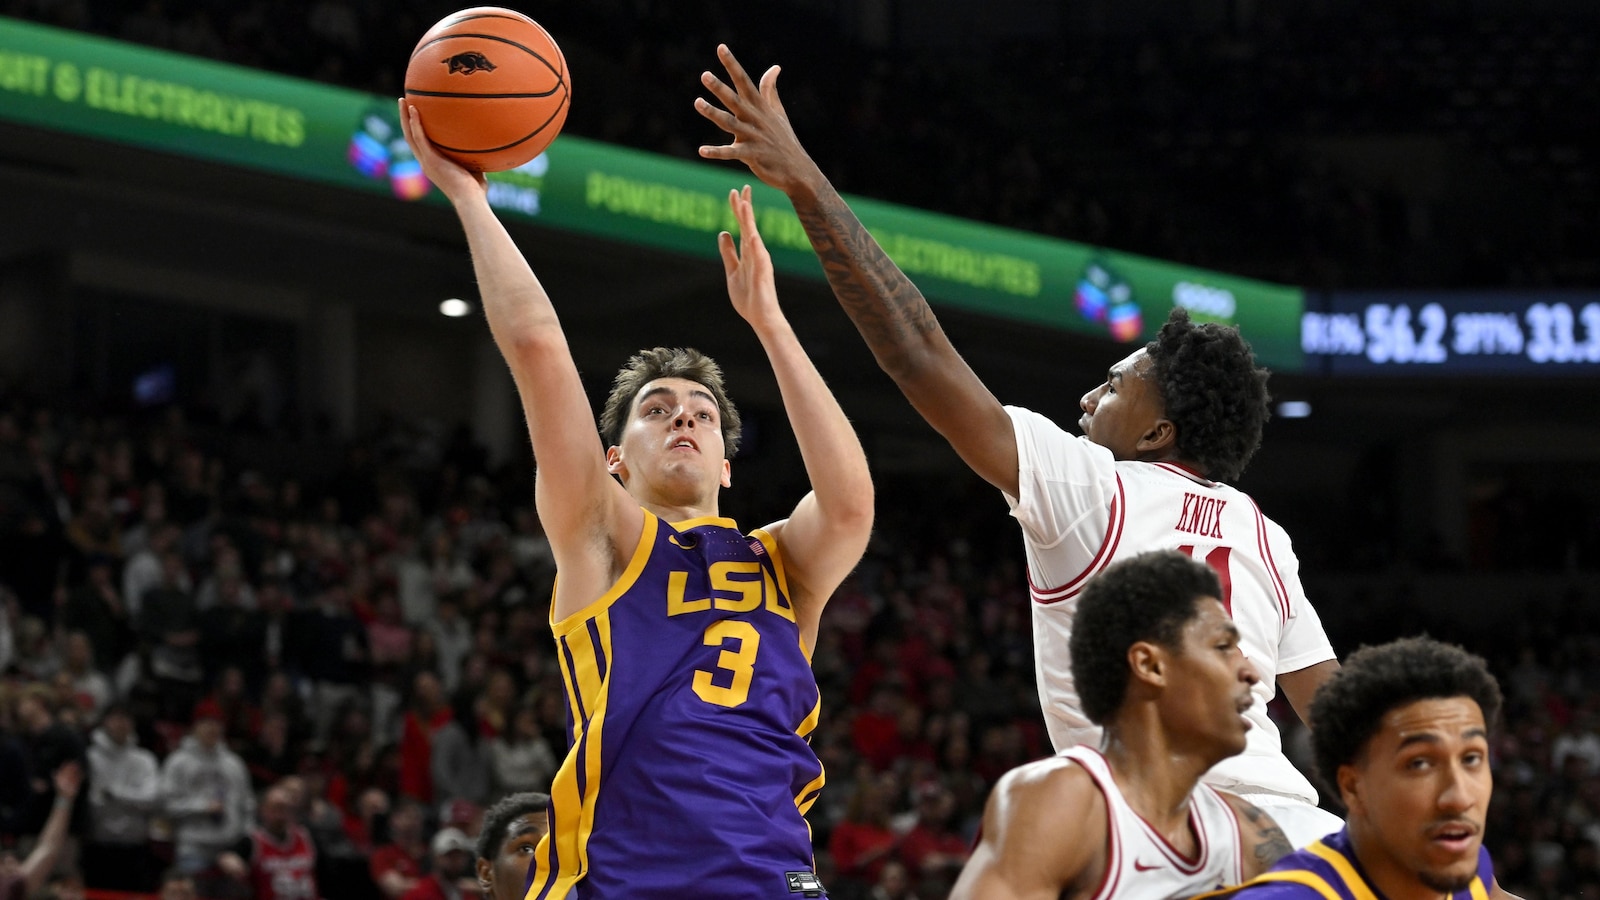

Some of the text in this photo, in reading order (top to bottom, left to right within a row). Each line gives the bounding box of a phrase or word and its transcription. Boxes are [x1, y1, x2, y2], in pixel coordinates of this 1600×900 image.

[53, 61, 81, 101] &
[85, 66, 304, 147] ELECTROLYTES
[586, 172, 720, 233] POWERED
[1365, 303, 1448, 364] 56.2
[1175, 491, 1227, 540] KNOX
[667, 561, 796, 624] LSU
[1176, 544, 1234, 620] 1
[691, 619, 761, 709] 3
